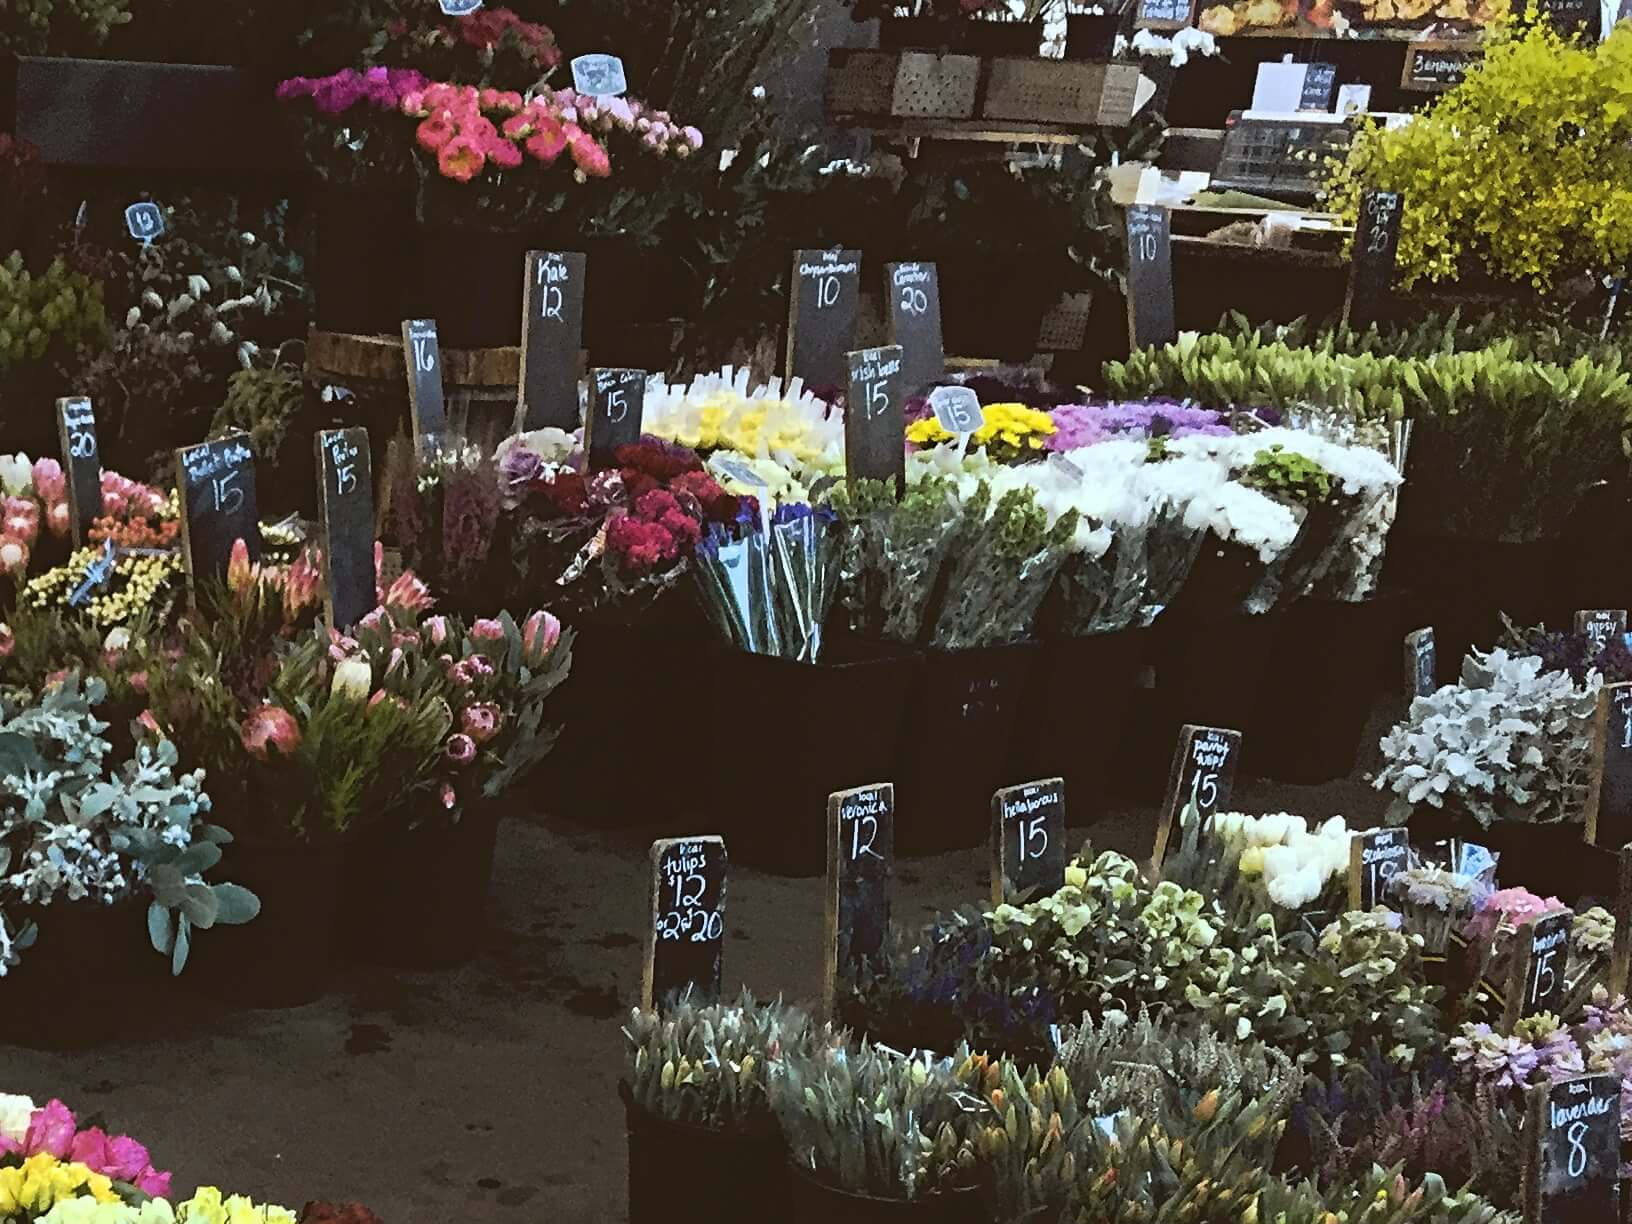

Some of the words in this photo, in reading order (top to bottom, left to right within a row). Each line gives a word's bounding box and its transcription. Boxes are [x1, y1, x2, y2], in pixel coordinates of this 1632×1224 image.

[1139, 234, 1157, 261] 10
[542, 285, 564, 322] 12
[817, 276, 841, 308] 10
[900, 287, 928, 316] 20
[607, 389, 628, 424] 15
[865, 380, 889, 420] 15
[947, 405, 972, 430] 15
[70, 432, 96, 458] 20
[212, 470, 244, 515] 15
[336, 463, 358, 495] 15
[1192, 769, 1218, 807] 15
[852, 816, 885, 860] 12
[1019, 816, 1048, 861] 15
[662, 855, 707, 876] tulips
[668, 874, 707, 907] $12
[663, 911, 681, 940] 2
[691, 910, 724, 942] 20
[1531, 950, 1557, 1004] 15
[1551, 1093, 1619, 1130] lavender
[1567, 1120, 1589, 1177] 8
